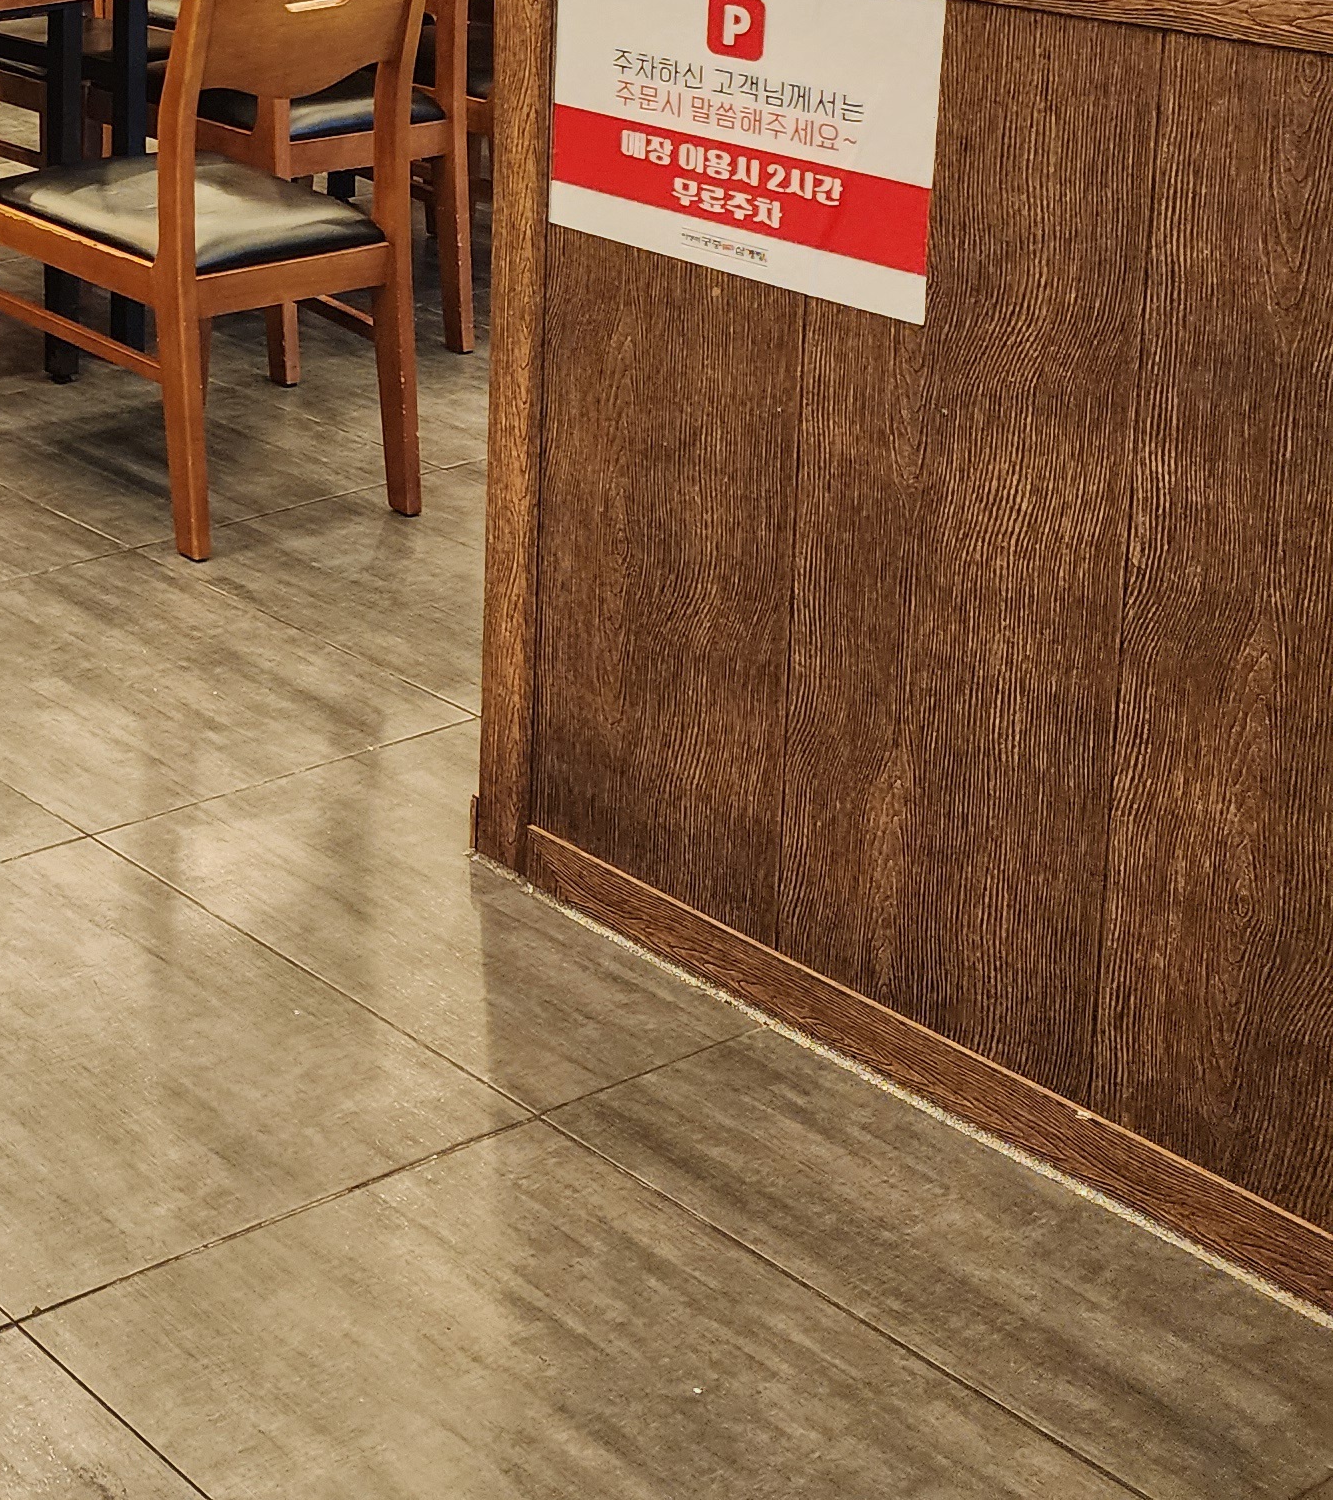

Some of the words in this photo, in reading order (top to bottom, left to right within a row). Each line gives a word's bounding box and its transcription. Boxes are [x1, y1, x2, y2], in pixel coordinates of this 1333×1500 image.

[722, 4, 752, 46] P
[612, 48, 704, 90] 주차하신
[711, 67, 865, 123] 고객님께서는
[615, 79, 682, 118] 주문시
[620, 129, 674, 166] 매장
[678, 143, 761, 187] 이용시
[766, 163, 844, 206] 2시간
[671, 176, 783, 229] 무료주차
